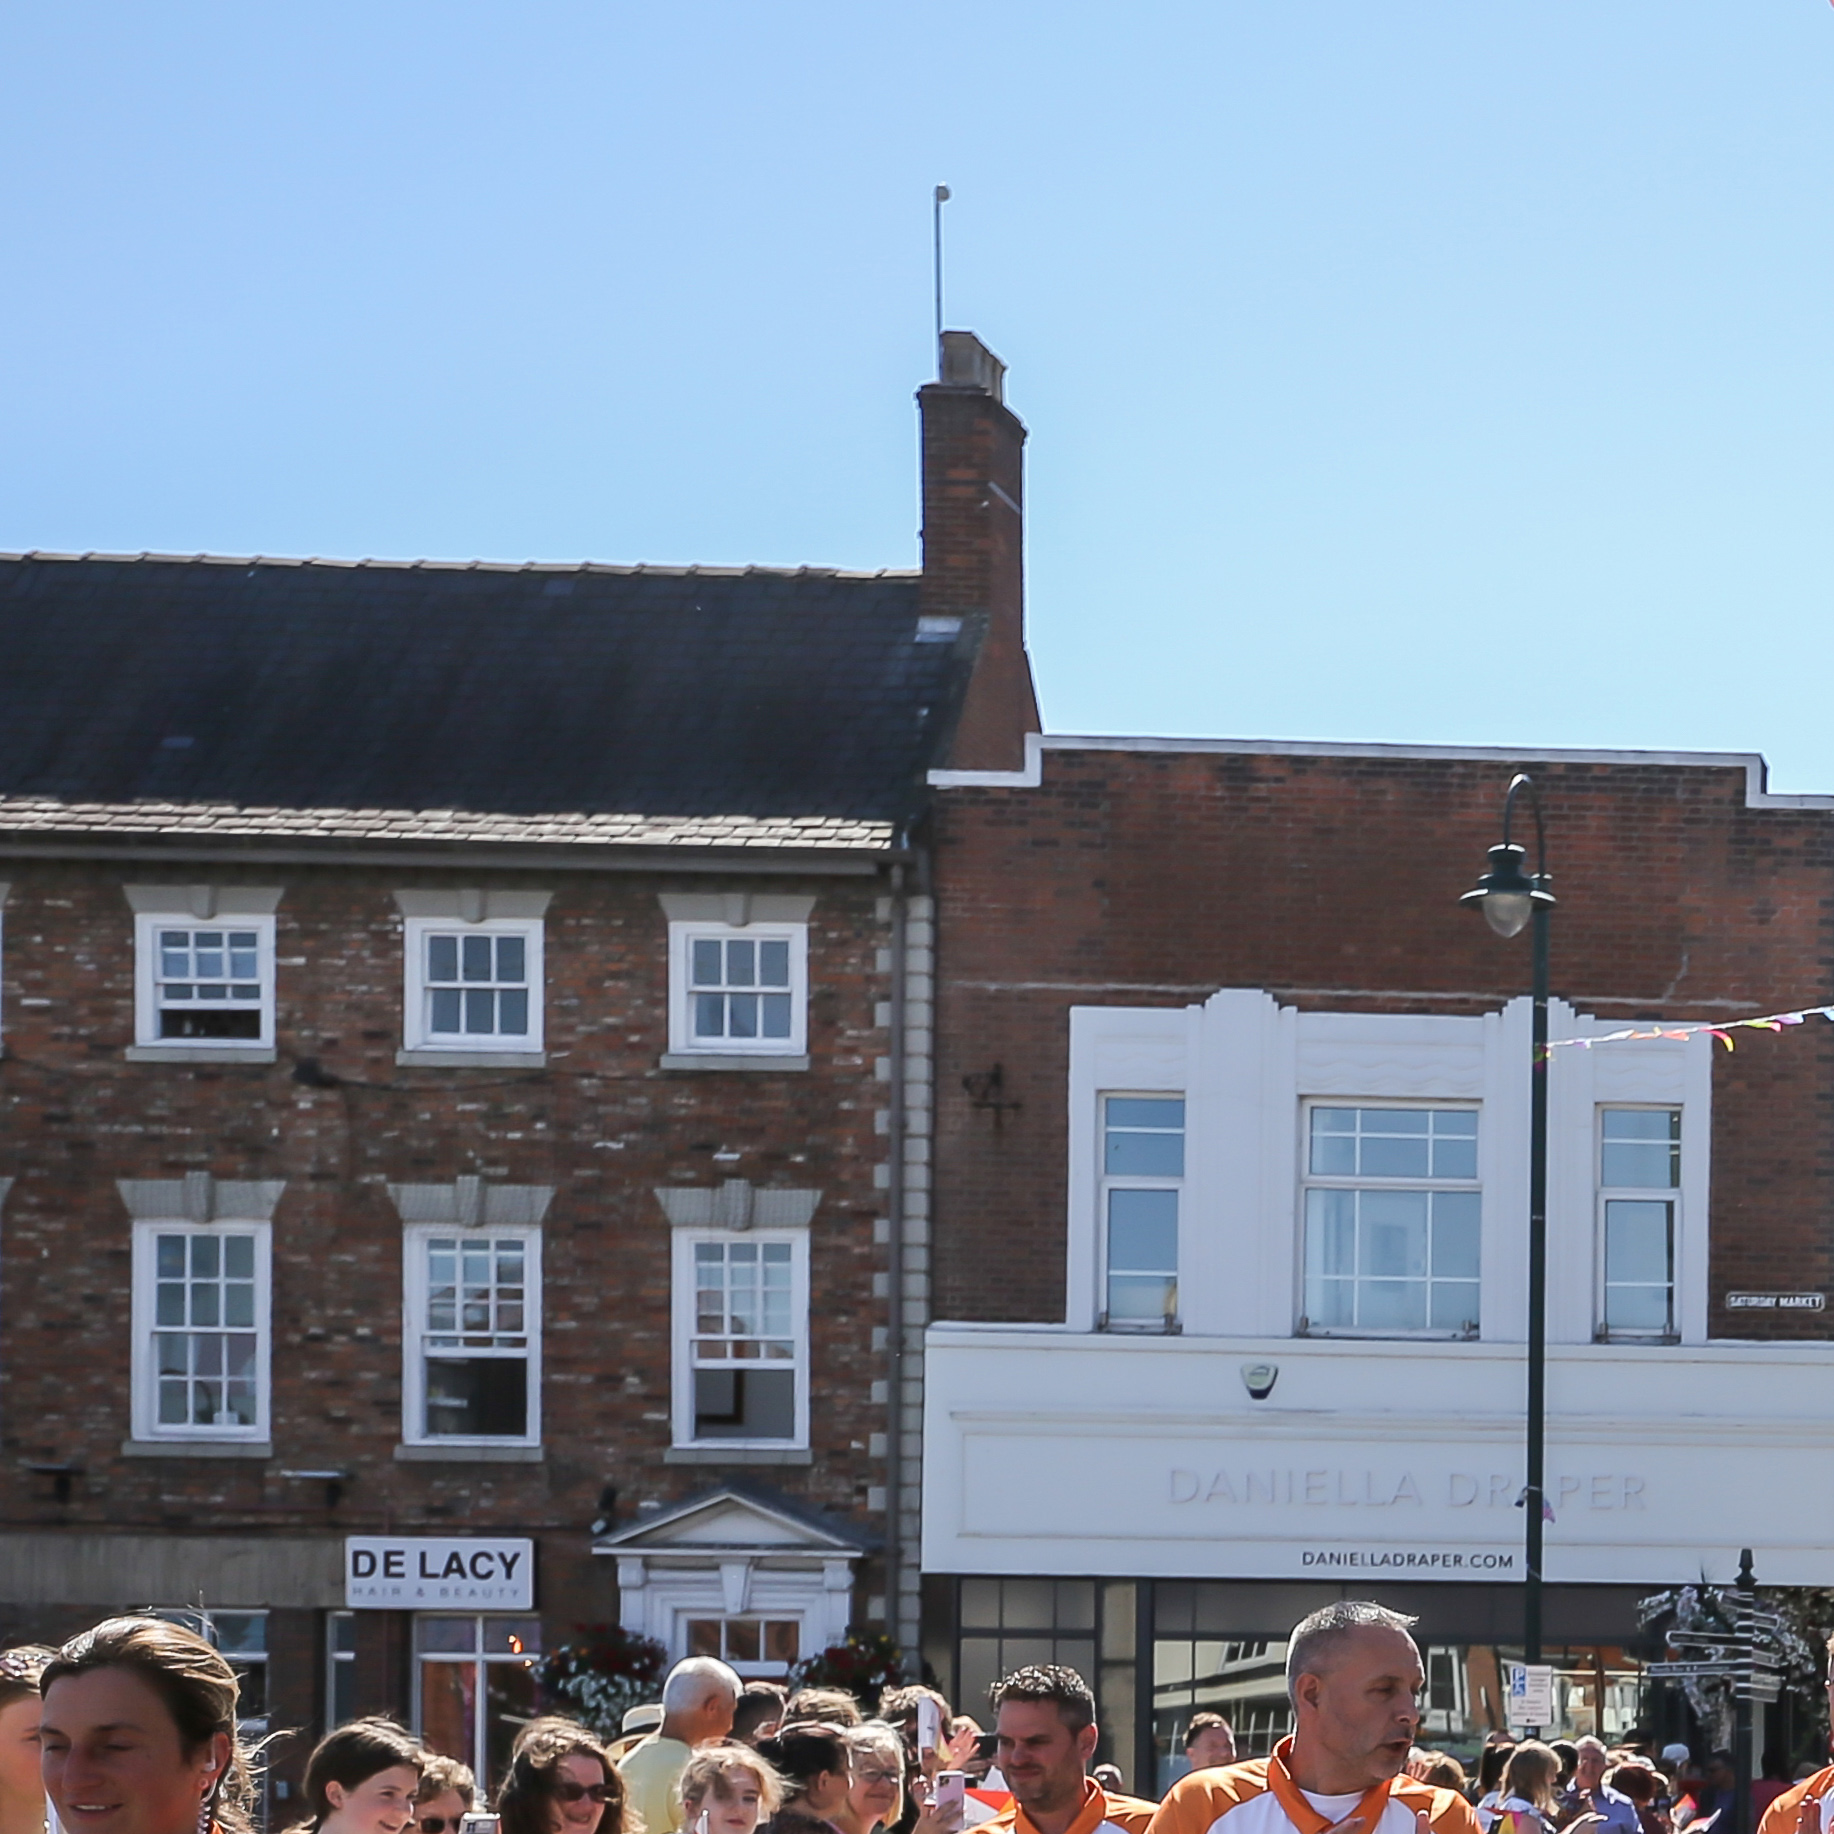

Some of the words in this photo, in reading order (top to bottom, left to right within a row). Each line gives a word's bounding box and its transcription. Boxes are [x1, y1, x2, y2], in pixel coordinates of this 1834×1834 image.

[1779, 1296, 1820, 1308] MARKET
[1169, 1467, 1421, 1507] DANIELLA
[1448, 1471, 1646, 1512] DRPER
[352, 1550, 406, 1579] DE
[419, 1551, 521, 1581] LACY
[1302, 1551, 1513, 1569] DANIELLADRAPER.COM
[353, 1586, 401, 1597] HAIR
[440, 1587, 520, 1598] BEAUTY
